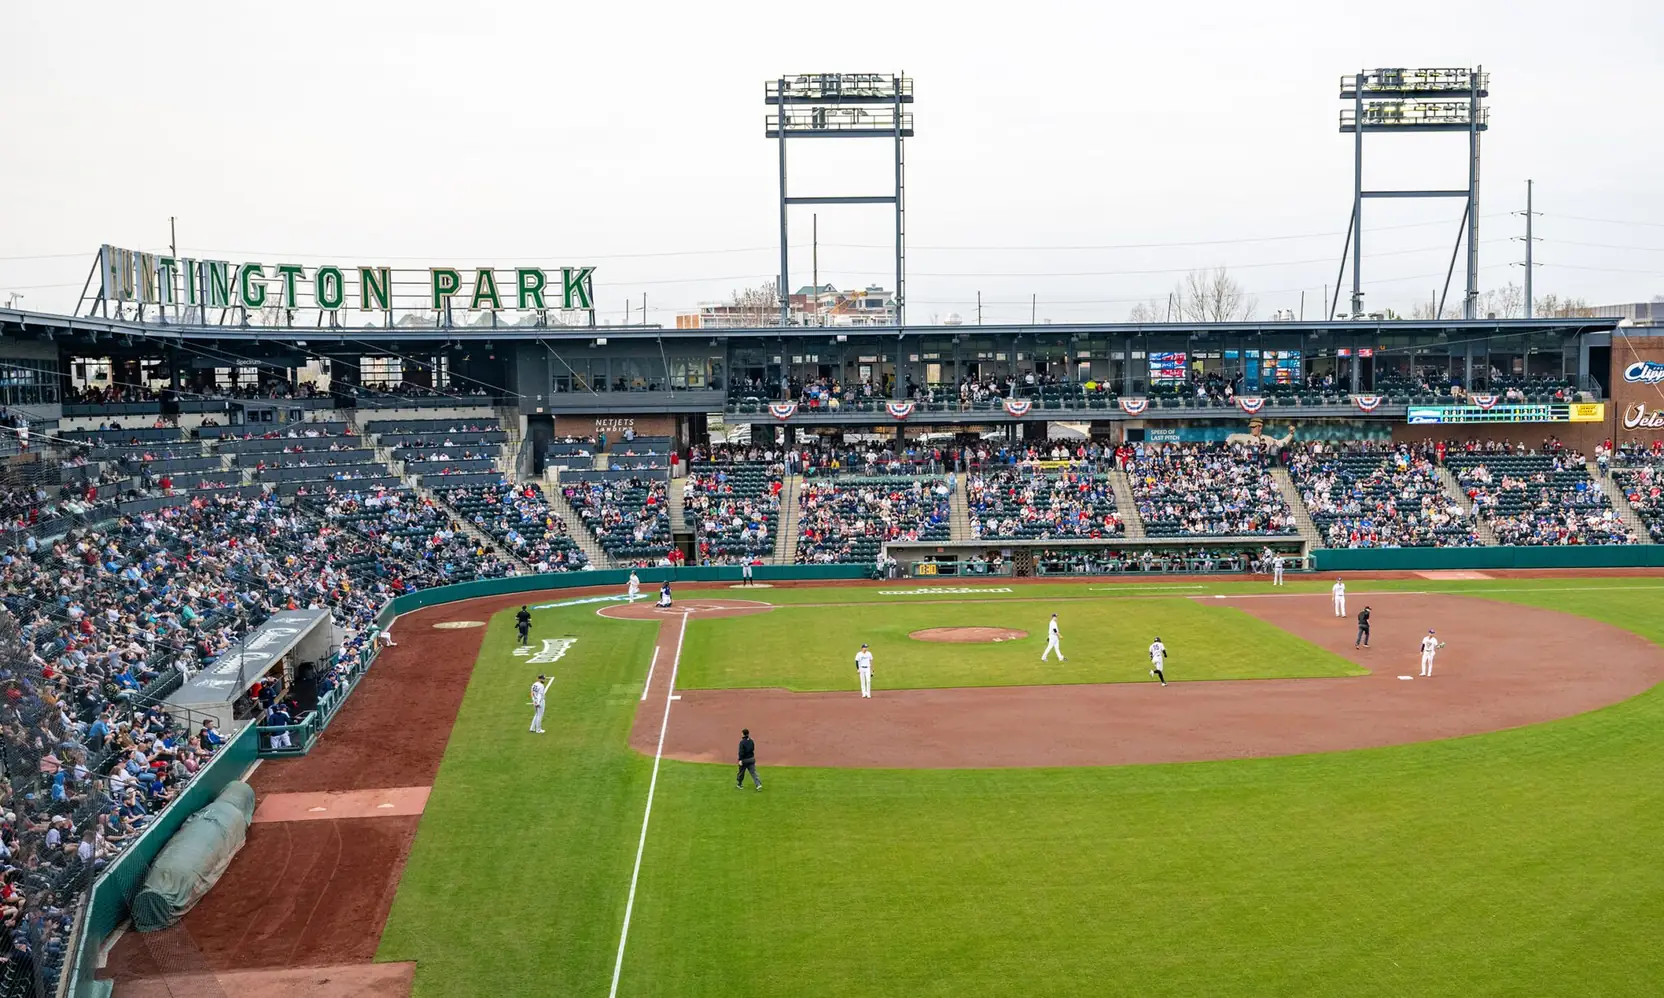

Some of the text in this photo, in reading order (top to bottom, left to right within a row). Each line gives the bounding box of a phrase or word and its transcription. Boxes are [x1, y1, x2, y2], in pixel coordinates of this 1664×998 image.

[102, 244, 597, 312] HUNTINGTON PARK
[595, 418, 634, 427] NETJETS
